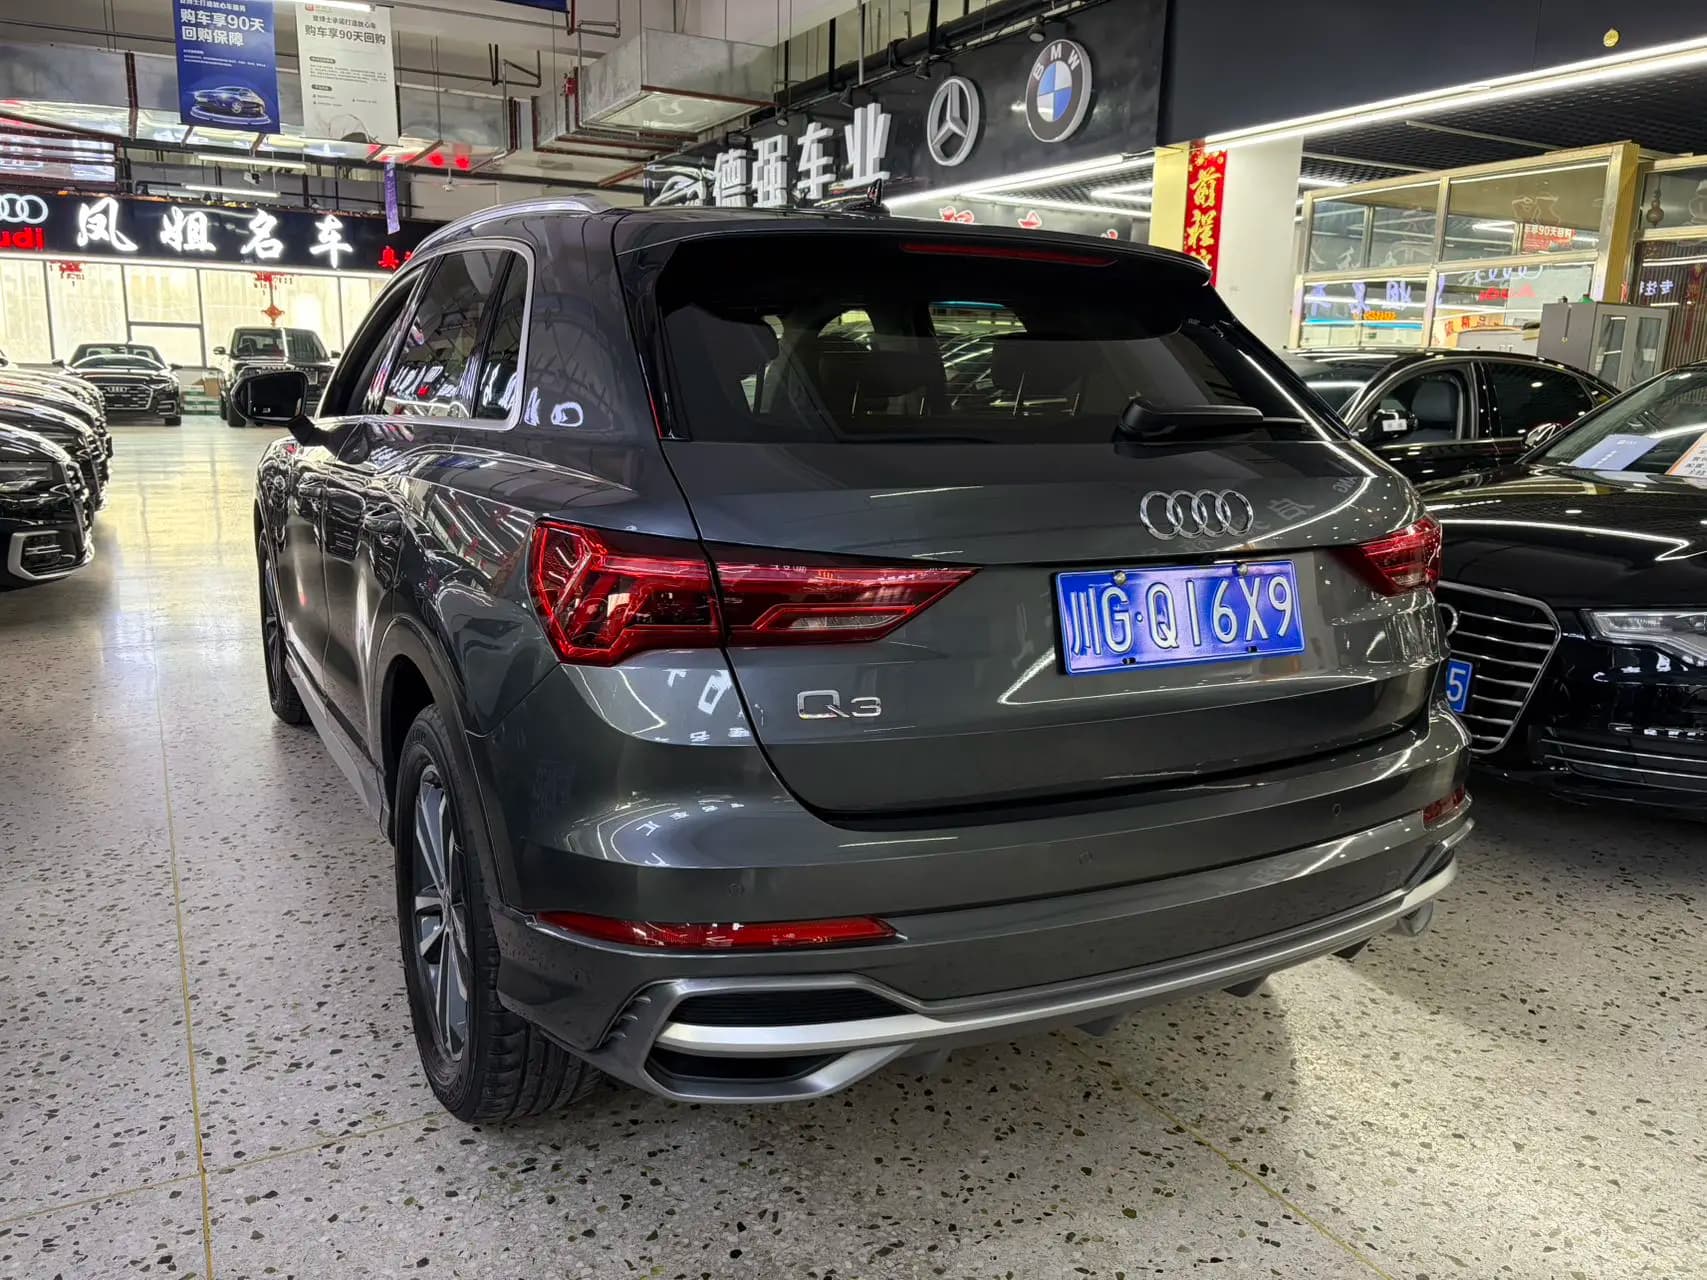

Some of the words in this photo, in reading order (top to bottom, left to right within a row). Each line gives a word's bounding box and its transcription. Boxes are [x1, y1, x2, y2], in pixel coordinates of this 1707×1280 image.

[180, 8, 265, 33] 购车享90天
[181, 26, 245, 47] 回购保障
[304, 24, 386, 45] 购车享90天回购
[1033, 43, 1080, 80] BMW
[713, 102, 892, 208] 德强车业
[77, 197, 353, 269] 凤姐名车
[1071, 576, 1293, 655] 川G·Q16X9
[1447, 667, 1466, 702] 5
[797, 690, 882, 719] Q3
